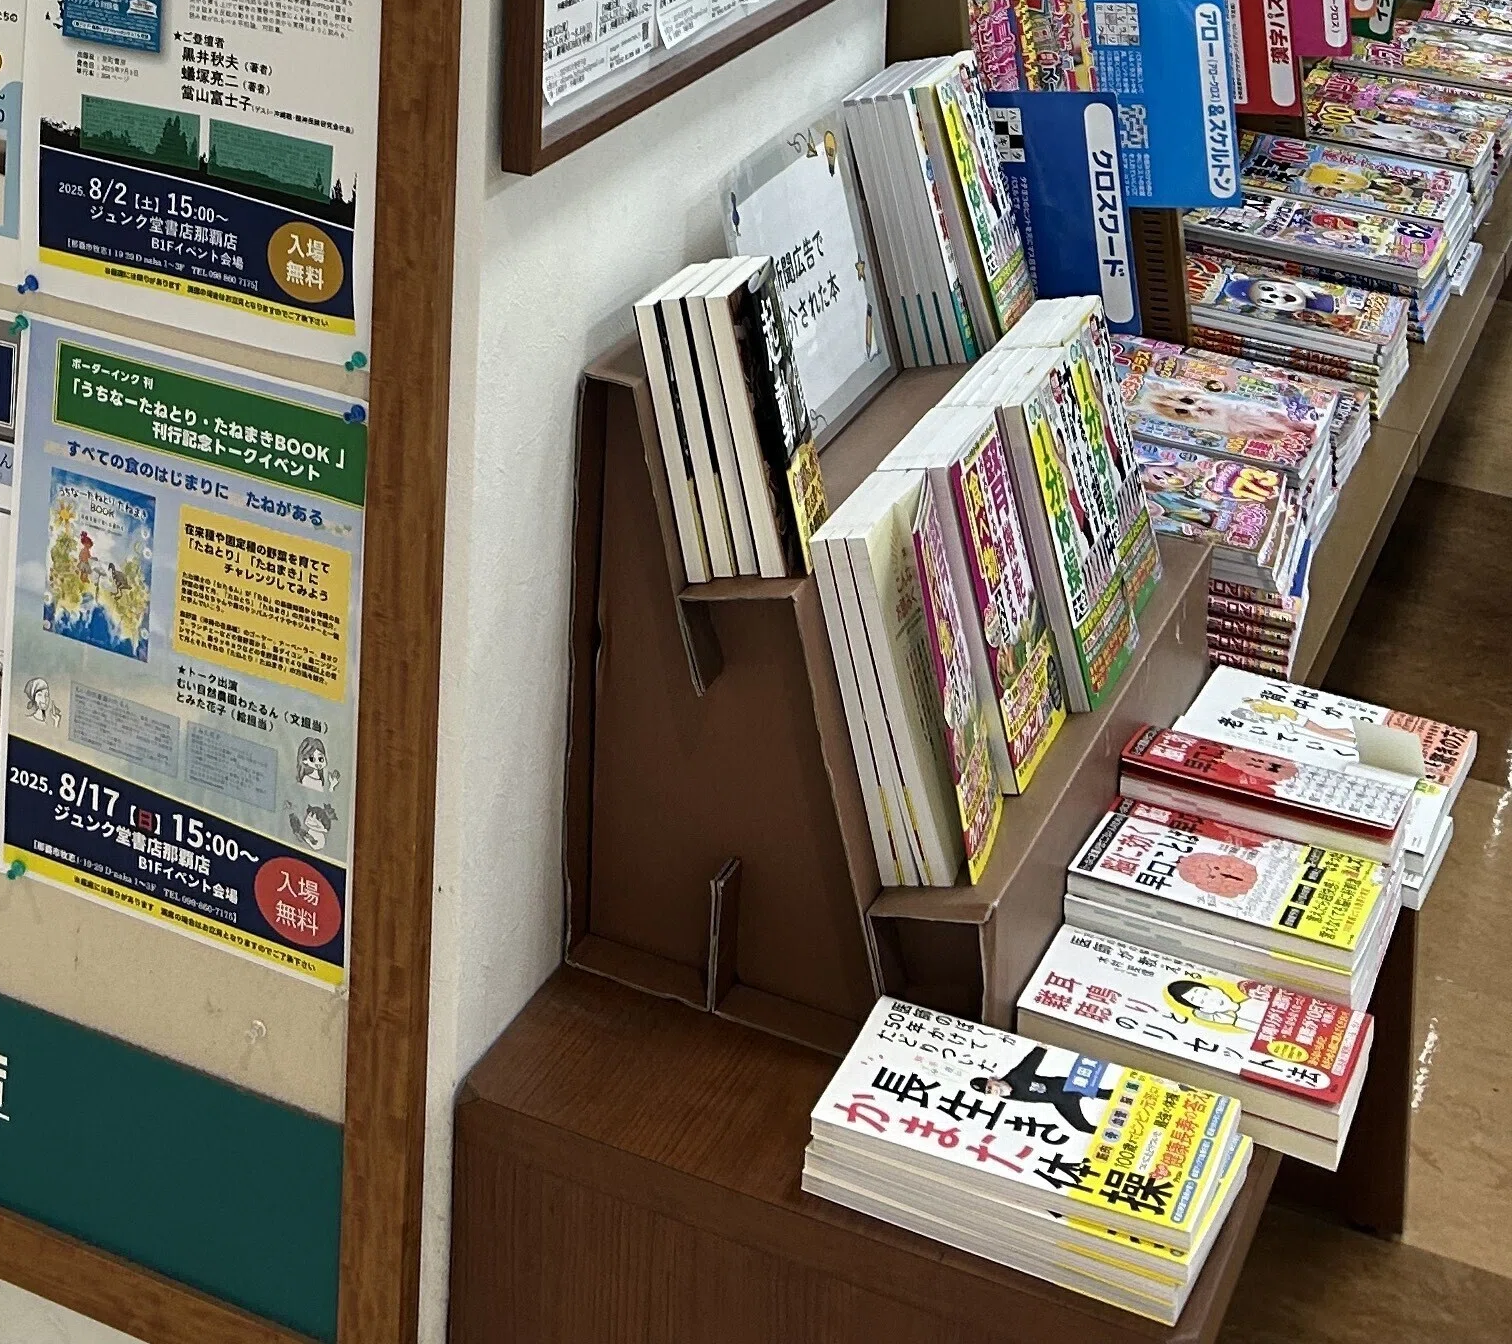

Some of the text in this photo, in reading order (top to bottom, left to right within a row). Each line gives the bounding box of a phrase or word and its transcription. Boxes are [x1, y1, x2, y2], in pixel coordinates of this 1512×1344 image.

[182, 48, 238, 71] 黒井秋夫
[182, 66, 238, 88] 蟻塚亮二
[59, 178, 127, 206] 2025. 8/2
[90, 206, 238, 250] ジュンク堂書店那覇店
[1088, 150, 1125, 279] クロスワード
[152, 237, 243, 270] B1Fイベント会場
[288, 234, 324, 262] 入場
[287, 262, 324, 290] 無料
[71, 357, 140, 385] ボーダーインク
[152, 421, 320, 481] 刊行記念トークイベント
[67, 440, 324, 526] すべての食のはじまりに たねがある
[224, 563, 328, 602] チャレンジしてみよう
[10, 767, 120, 817] 2025. 8/17
[54, 803, 211, 875] ジュンク堂書店那覇店
[139, 857, 238, 905] B1Fイベント会場
[278, 871, 320, 907] 入場
[276, 902, 319, 936] 無料
[890, 1002, 1017, 1047] 医師のぼくが
[876, 1029, 998, 1074] たどりついた
[871, 1066, 1070, 1146] 長生き
